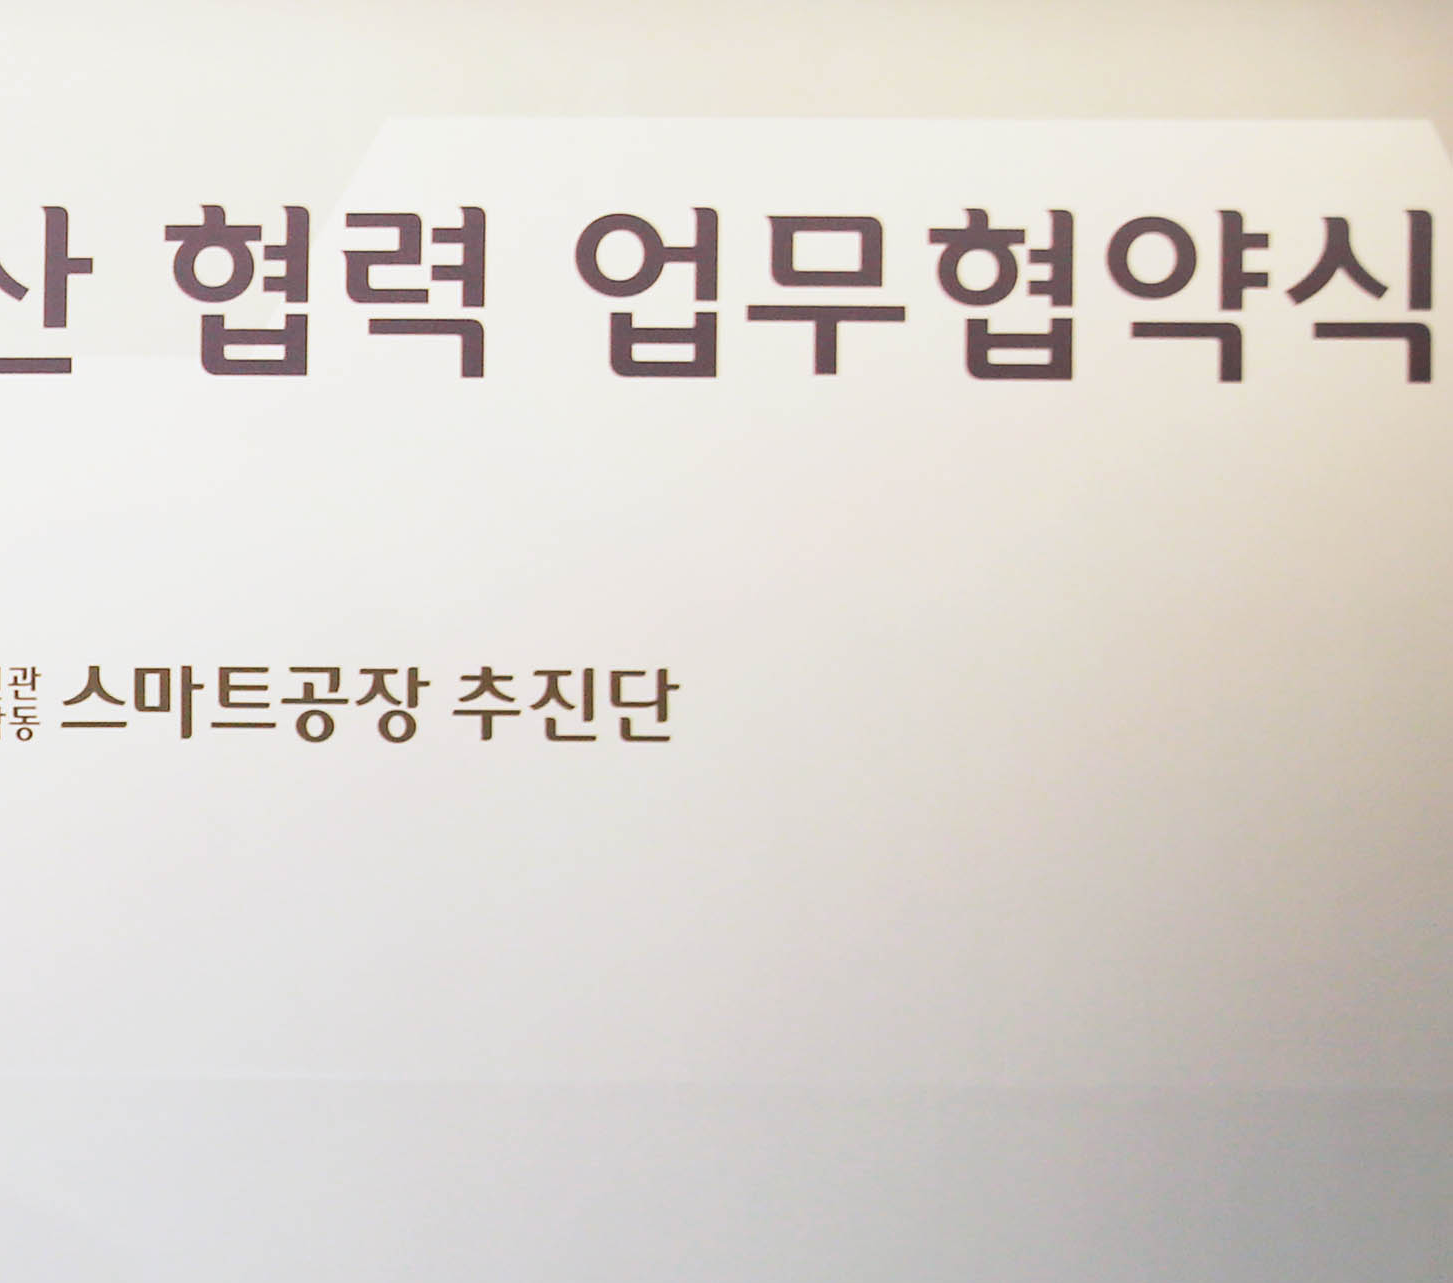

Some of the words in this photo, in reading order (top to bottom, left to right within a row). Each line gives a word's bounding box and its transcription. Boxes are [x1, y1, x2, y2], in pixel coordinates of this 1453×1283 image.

[166, 205, 485, 377] 협력
[576, 208, 1432, 383] 업무협약식
[61, 665, 431, 743] 스마트공장
[452, 666, 680, 742] 추진단
